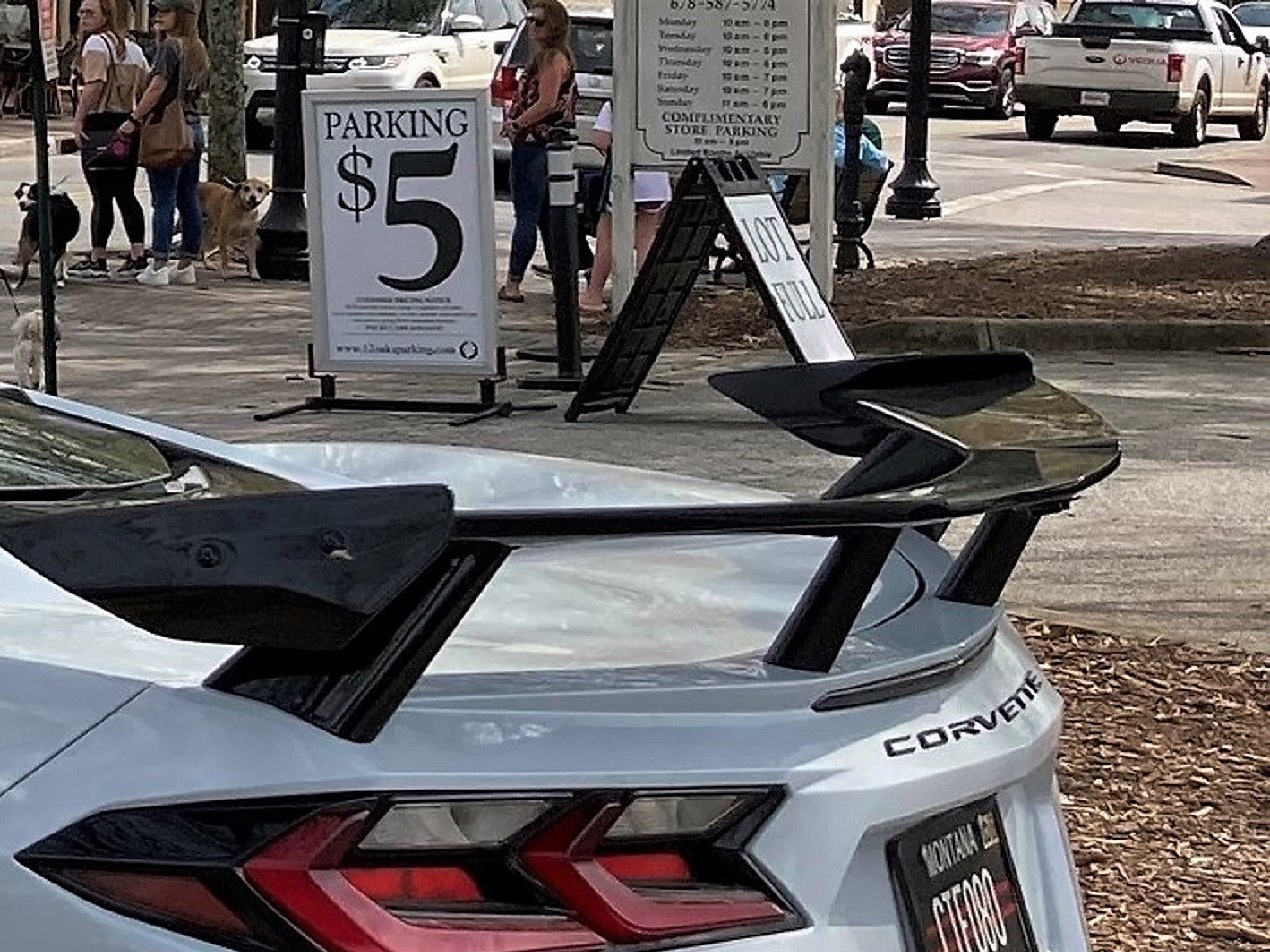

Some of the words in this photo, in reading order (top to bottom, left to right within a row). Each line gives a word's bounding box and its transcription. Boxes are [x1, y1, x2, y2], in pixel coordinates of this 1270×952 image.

[324, 108, 468, 140] PARKING
[662, 111, 781, 125] COMPLIMENTARY
[665, 124, 708, 135] STORE
[716, 125, 778, 137] PARKING
[337, 142, 463, 292] $5
[740, 216, 794, 263] LOT
[772, 280, 826, 322] FULL
[883, 670, 1043, 758] CORVETTE
[921, 822, 979, 877] MONTANA
